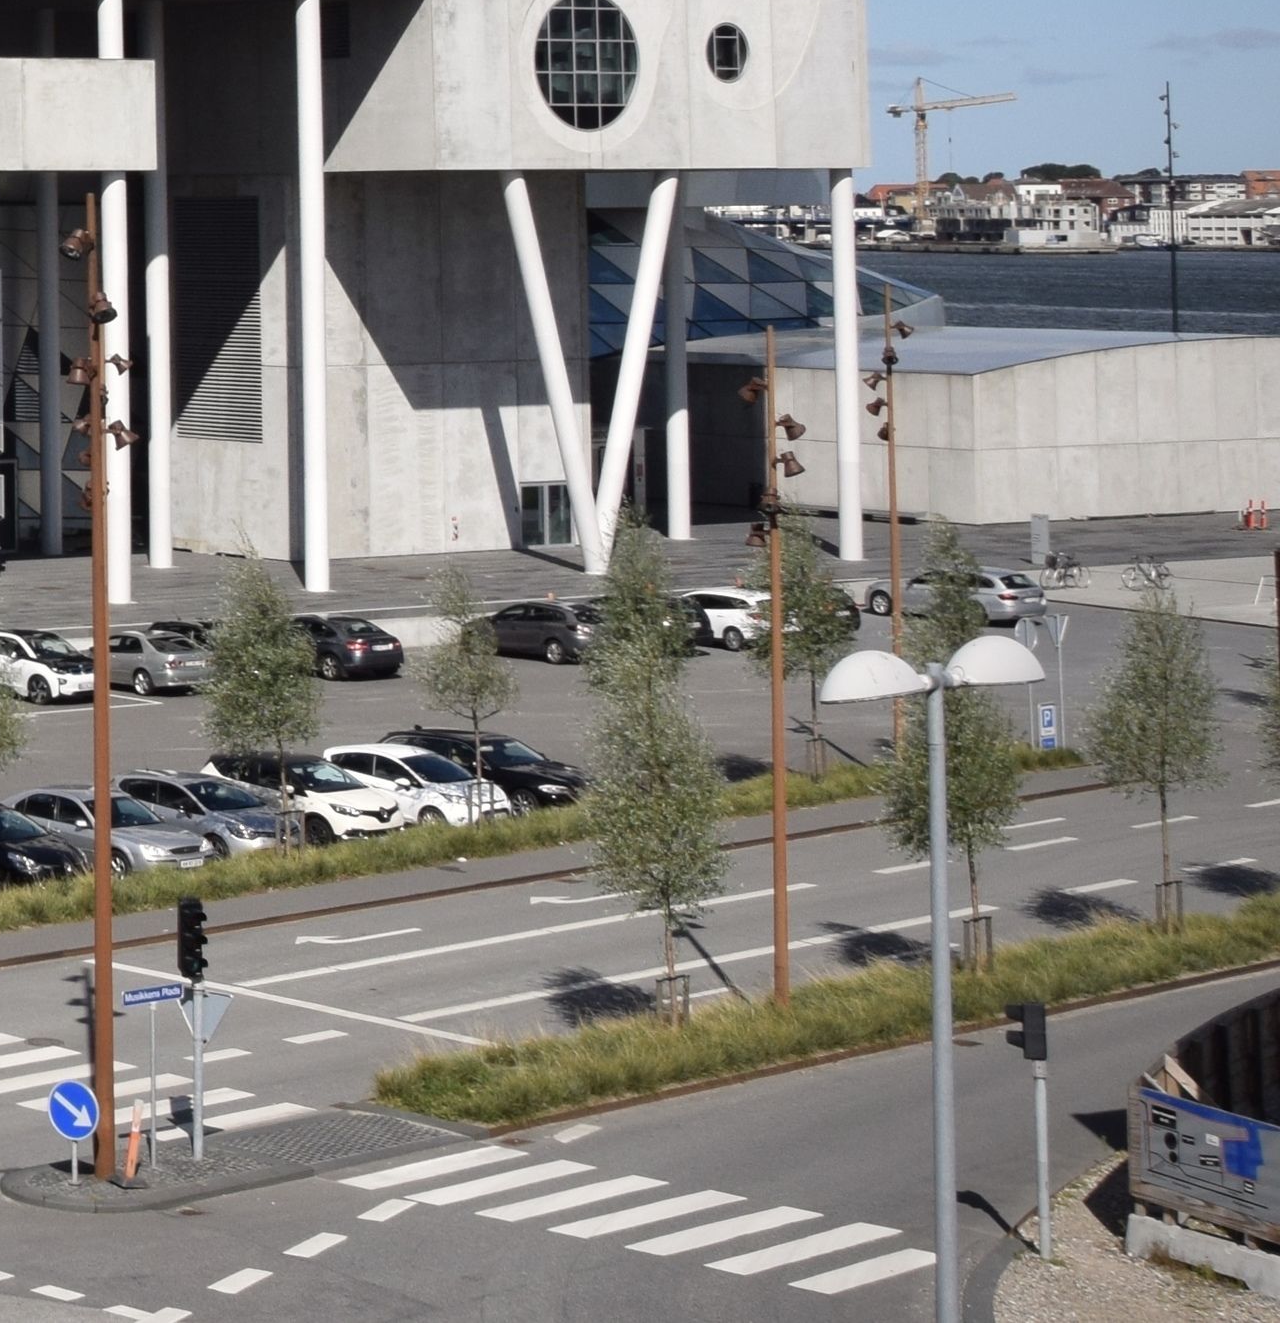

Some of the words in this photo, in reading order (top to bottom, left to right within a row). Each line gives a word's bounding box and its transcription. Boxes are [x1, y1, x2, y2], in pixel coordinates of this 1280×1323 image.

[1043, 710, 1051, 726] P
[124, 990, 160, 1002] Musikkens
[161, 986, 181, 997] Plads
